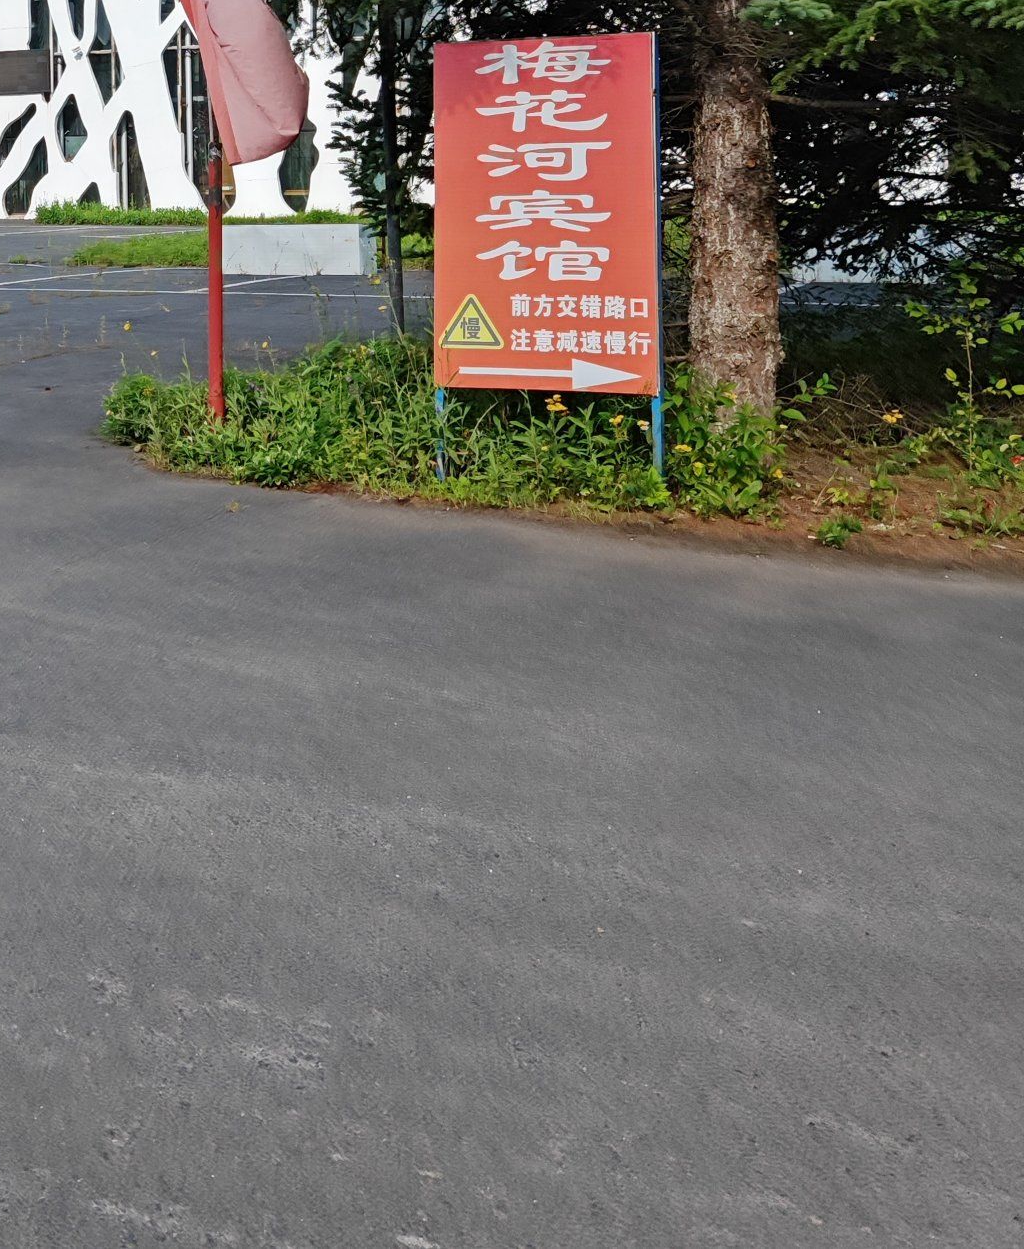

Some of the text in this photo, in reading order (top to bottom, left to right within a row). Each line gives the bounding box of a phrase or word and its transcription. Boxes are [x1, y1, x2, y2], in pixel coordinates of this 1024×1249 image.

[475, 41, 612, 281] 梅花河宾馆
[509, 293, 649, 319] 前方交错路口
[459, 316, 481, 340] 慢
[509, 328, 652, 355] 注意减速慢行
